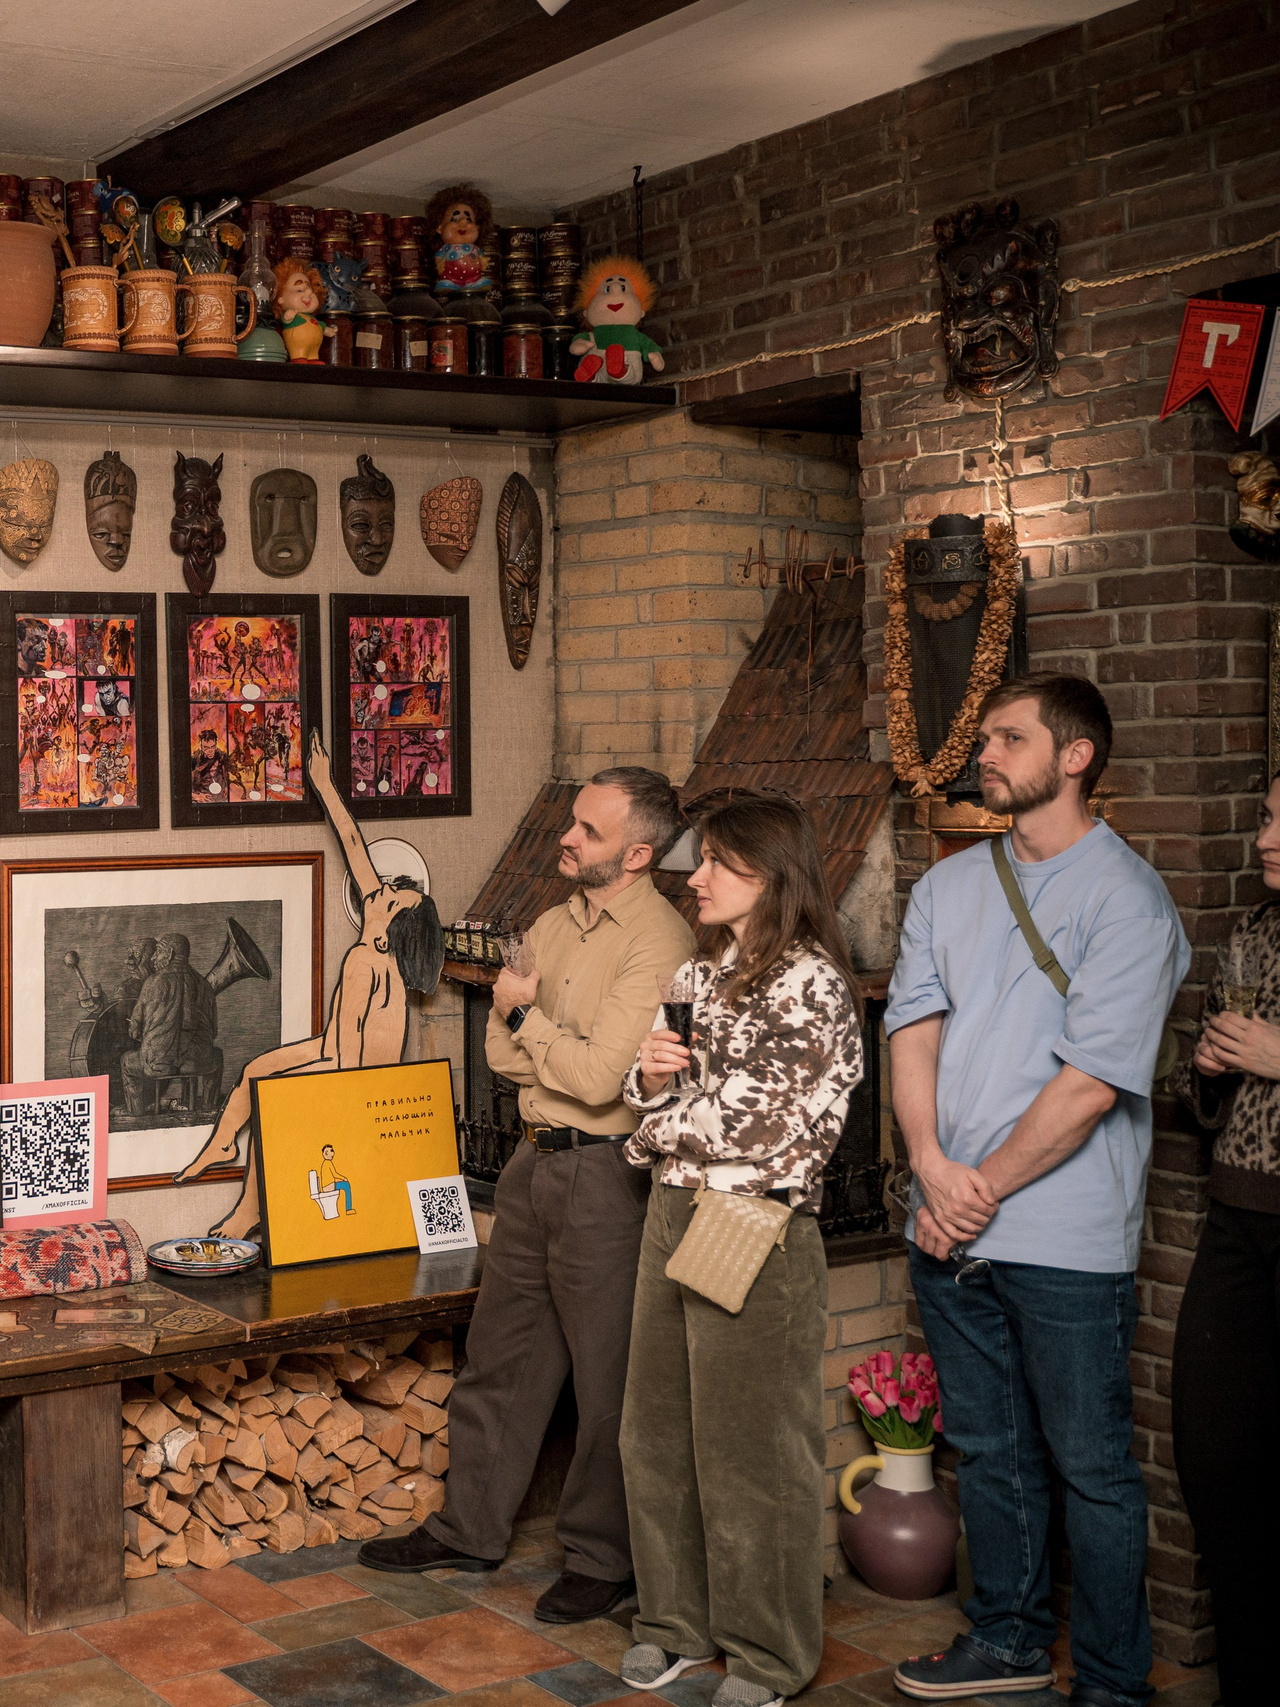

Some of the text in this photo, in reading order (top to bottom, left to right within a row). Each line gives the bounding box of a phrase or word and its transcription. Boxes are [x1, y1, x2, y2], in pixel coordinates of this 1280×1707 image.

[366, 1095, 432, 1109] ПРАВИЛЬНО
[375, 1108, 434, 1123] ПИСАЮЩИЙ
[380, 1128, 430, 1140] МАЛЬЧИК
[41, 1199, 89, 1210] /XMAXOFFICIAL
